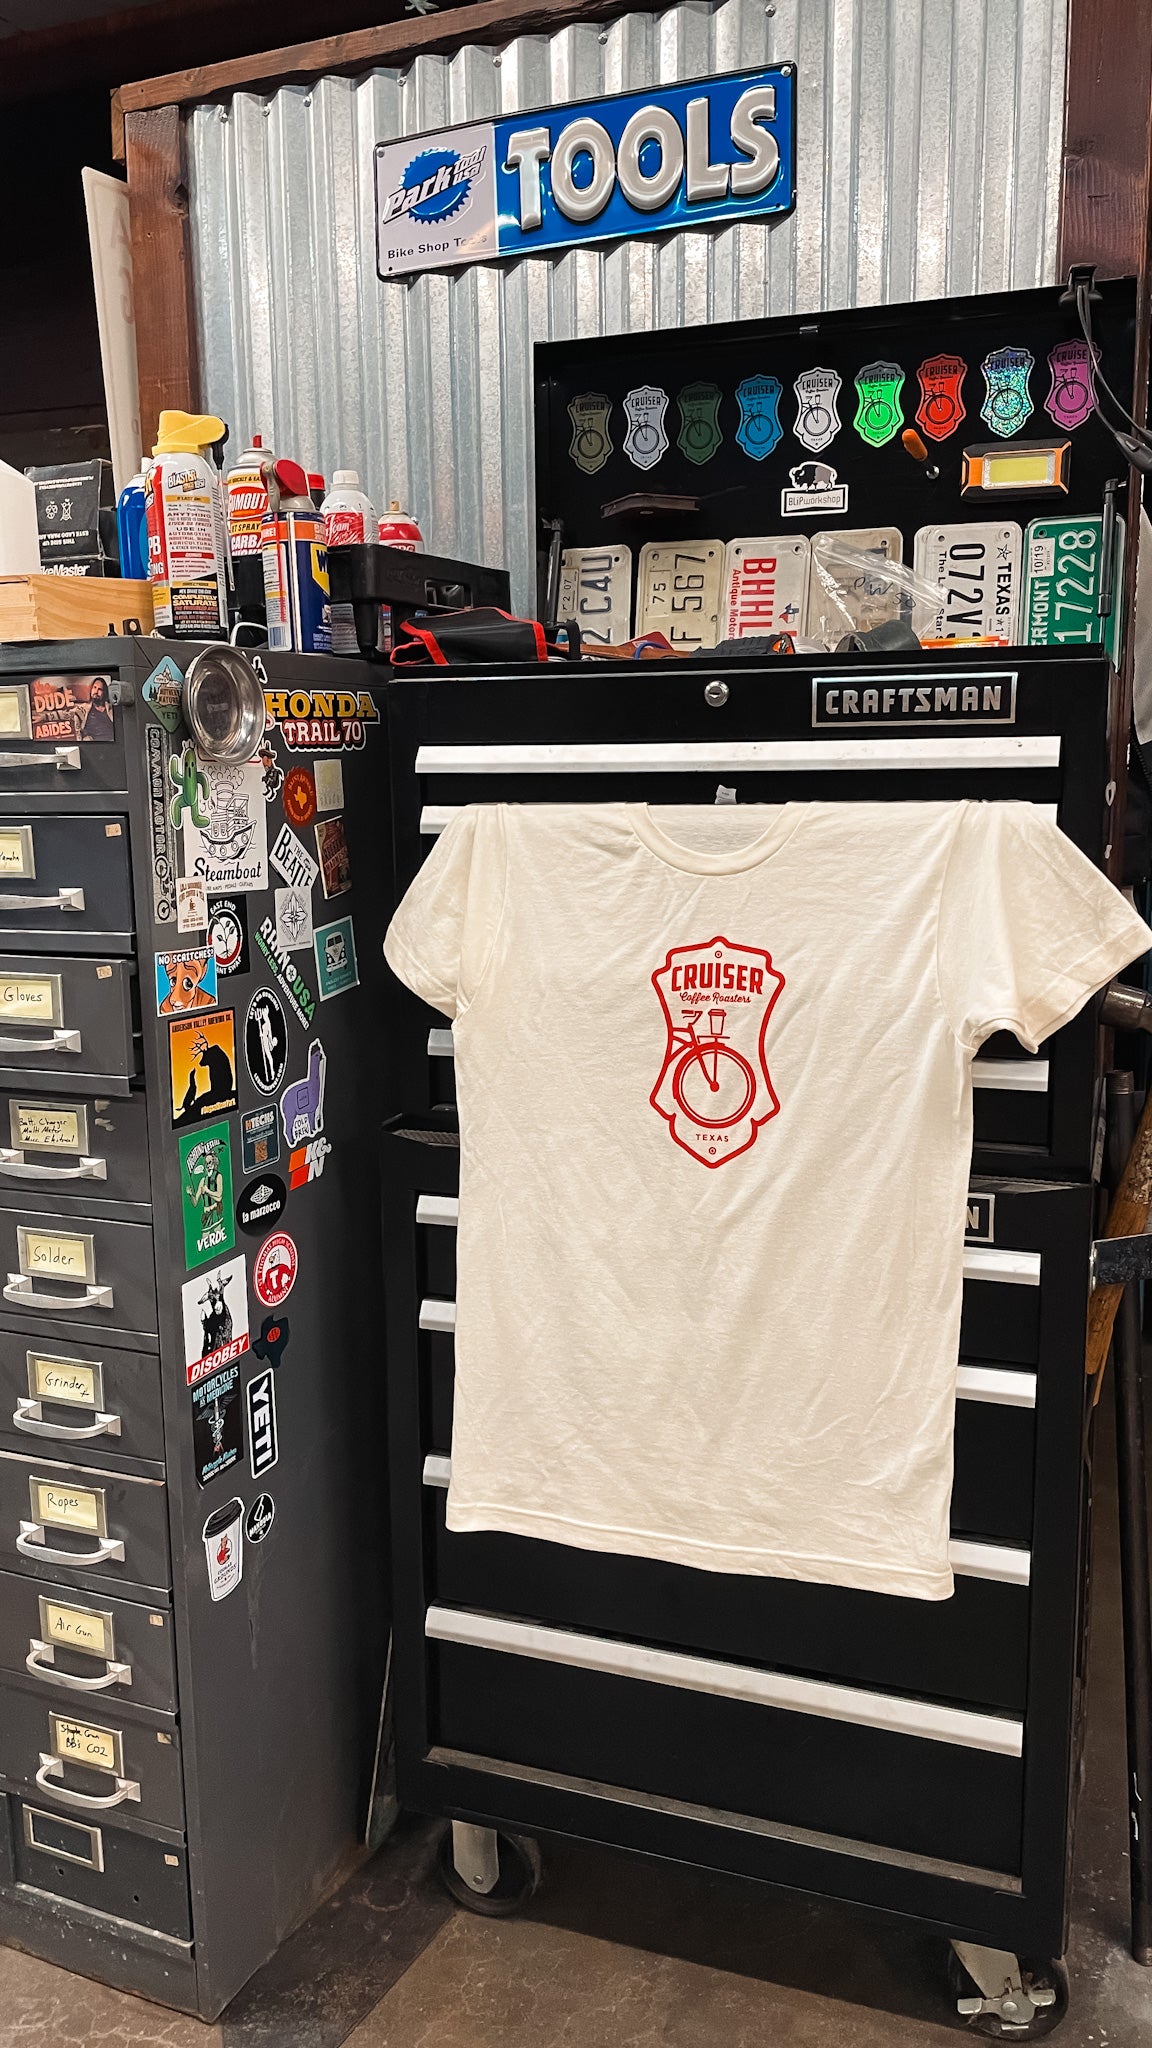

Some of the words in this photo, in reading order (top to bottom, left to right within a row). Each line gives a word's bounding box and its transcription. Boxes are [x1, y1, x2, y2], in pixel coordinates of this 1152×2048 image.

[506, 85, 780, 231] TOOLS
[382, 165, 453, 224] Park
[387, 248, 414, 259] Bike
[418, 241, 450, 253] Shop
[990, 357, 1025, 370] CRUISER
[1056, 349, 1089, 362] CRUISE
[864, 373, 896, 385] CRUISER
[925, 365, 958, 378] CRUISER
[743, 384, 775, 397] CRUISER
[802, 377, 834, 390] CRUISER
[631, 396, 661, 408] CRUISER
[238, 523, 260, 532] SPRAY
[938, 550, 948, 573] The
[1033, 545, 1044, 574] 10/19
[730, 568, 742, 606] Antique
[946, 543, 987, 639] 072V
[995, 562, 1012, 615] TEXAS
[1053, 528, 1098, 643] 17228
[1030, 579, 1050, 646] ERMONT
[34, 689, 76, 713] DUDE
[264, 692, 377, 718] HONDA
[825, 685, 1002, 716] CRAFTSMAN
[162, 711, 178, 720] YETI
[36, 721, 72, 738] ABIDES
[284, 721, 341, 742] TRAIL
[341, 720, 362, 741] 70
[294, 843, 303, 861] THE
[193, 857, 262, 881] Steamboat
[209, 900, 223, 914] EAST
[224, 900, 236, 911] END
[158, 955, 170, 965] NO
[172, 948, 214, 963] SCRITCHES?
[254, 931, 270, 957] WORRY
[266, 954, 279, 977] LESS,
[276, 973, 300, 1011] ADVENTURE
[671, 962, 764, 995] CRUISER
[3, 986, 43, 1003] Gloves
[679, 991, 711, 1005] Coffee
[712, 991, 752, 1005] Roasters
[39, 1117, 67, 1130] Charger
[41, 1125, 62, 1133] Meter
[294, 1116, 308, 1128] COLD
[294, 1126, 310, 1139] BREW
[695, 1133, 730, 1142] TEXAS
[242, 1211, 250, 1224] la
[250, 1199, 281, 1221] marzocco
[196, 1226, 227, 1252] VERDE
[33, 1244, 74, 1266] Solder
[190, 1335, 248, 1381] DISOBEY
[44, 1371, 85, 1390] Grinder
[192, 1366, 239, 1403] MOTORCYCLES
[206, 1380, 234, 1403] MEDICINE
[252, 1377, 272, 1467] YETI
[47, 1492, 79, 1514] Ropes
[54, 1616, 71, 1632] Air
[75, 1625, 93, 1638] Gun
[84, 1729, 100, 1740] Gun
[86, 1743, 109, 1757] CO2
